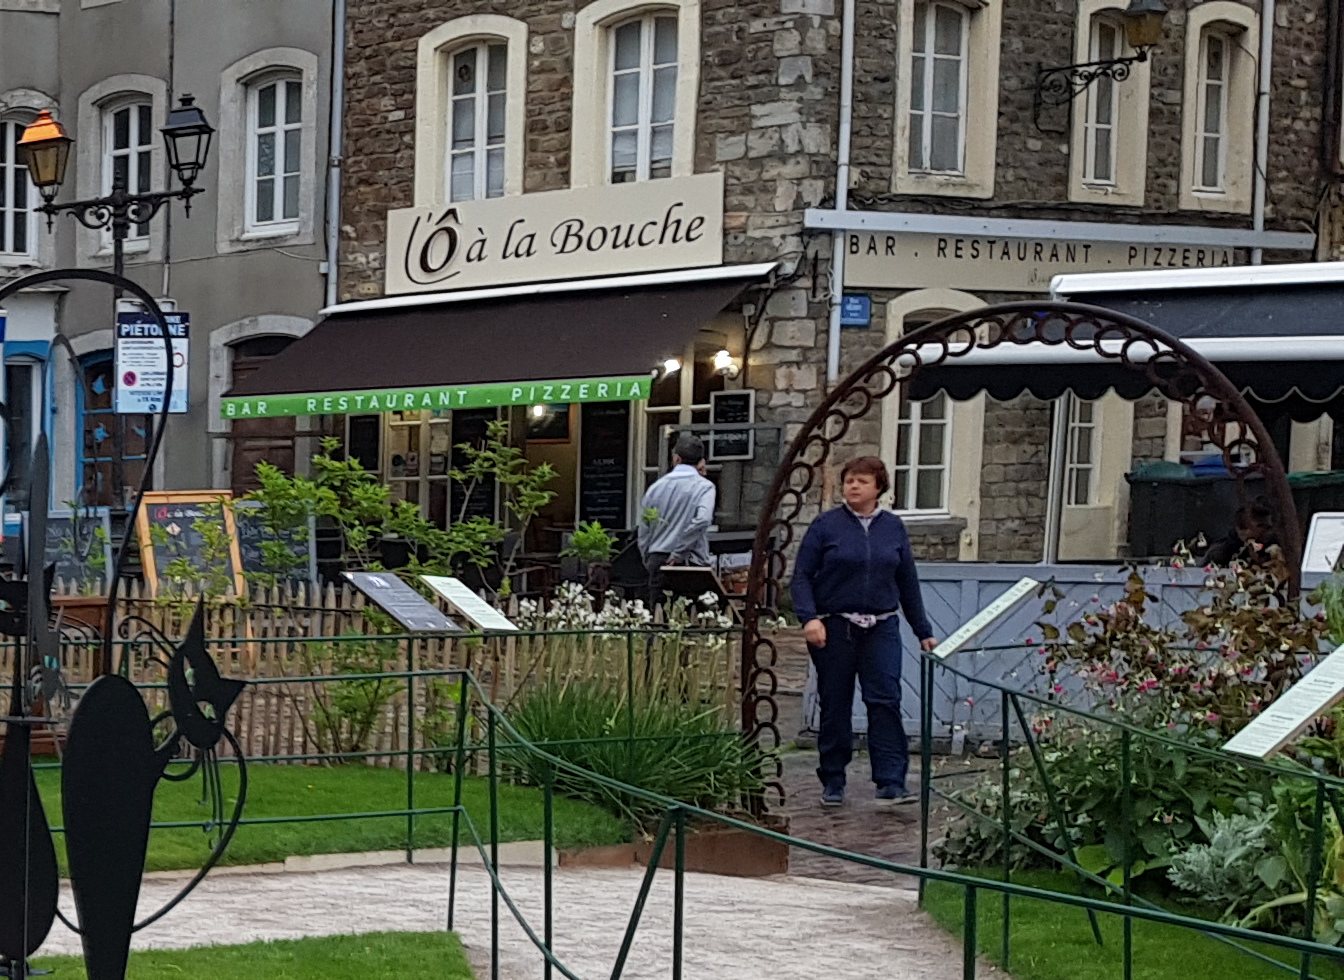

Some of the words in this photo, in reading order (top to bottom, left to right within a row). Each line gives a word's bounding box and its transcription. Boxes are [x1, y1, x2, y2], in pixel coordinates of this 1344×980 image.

[465, 227, 488, 263] à
[501, 218, 538, 260] la
[550, 201, 706, 256] Bouche
[849, 233, 897, 257] BAR
[936, 237, 1093, 264] RESTAURANT
[1127, 244, 1231, 268] PIZZERIA
[225, 401, 267, 416] BAR
[307, 390, 468, 413] RESTAURANT
[511, 381, 643, 402] PIZZERIA
